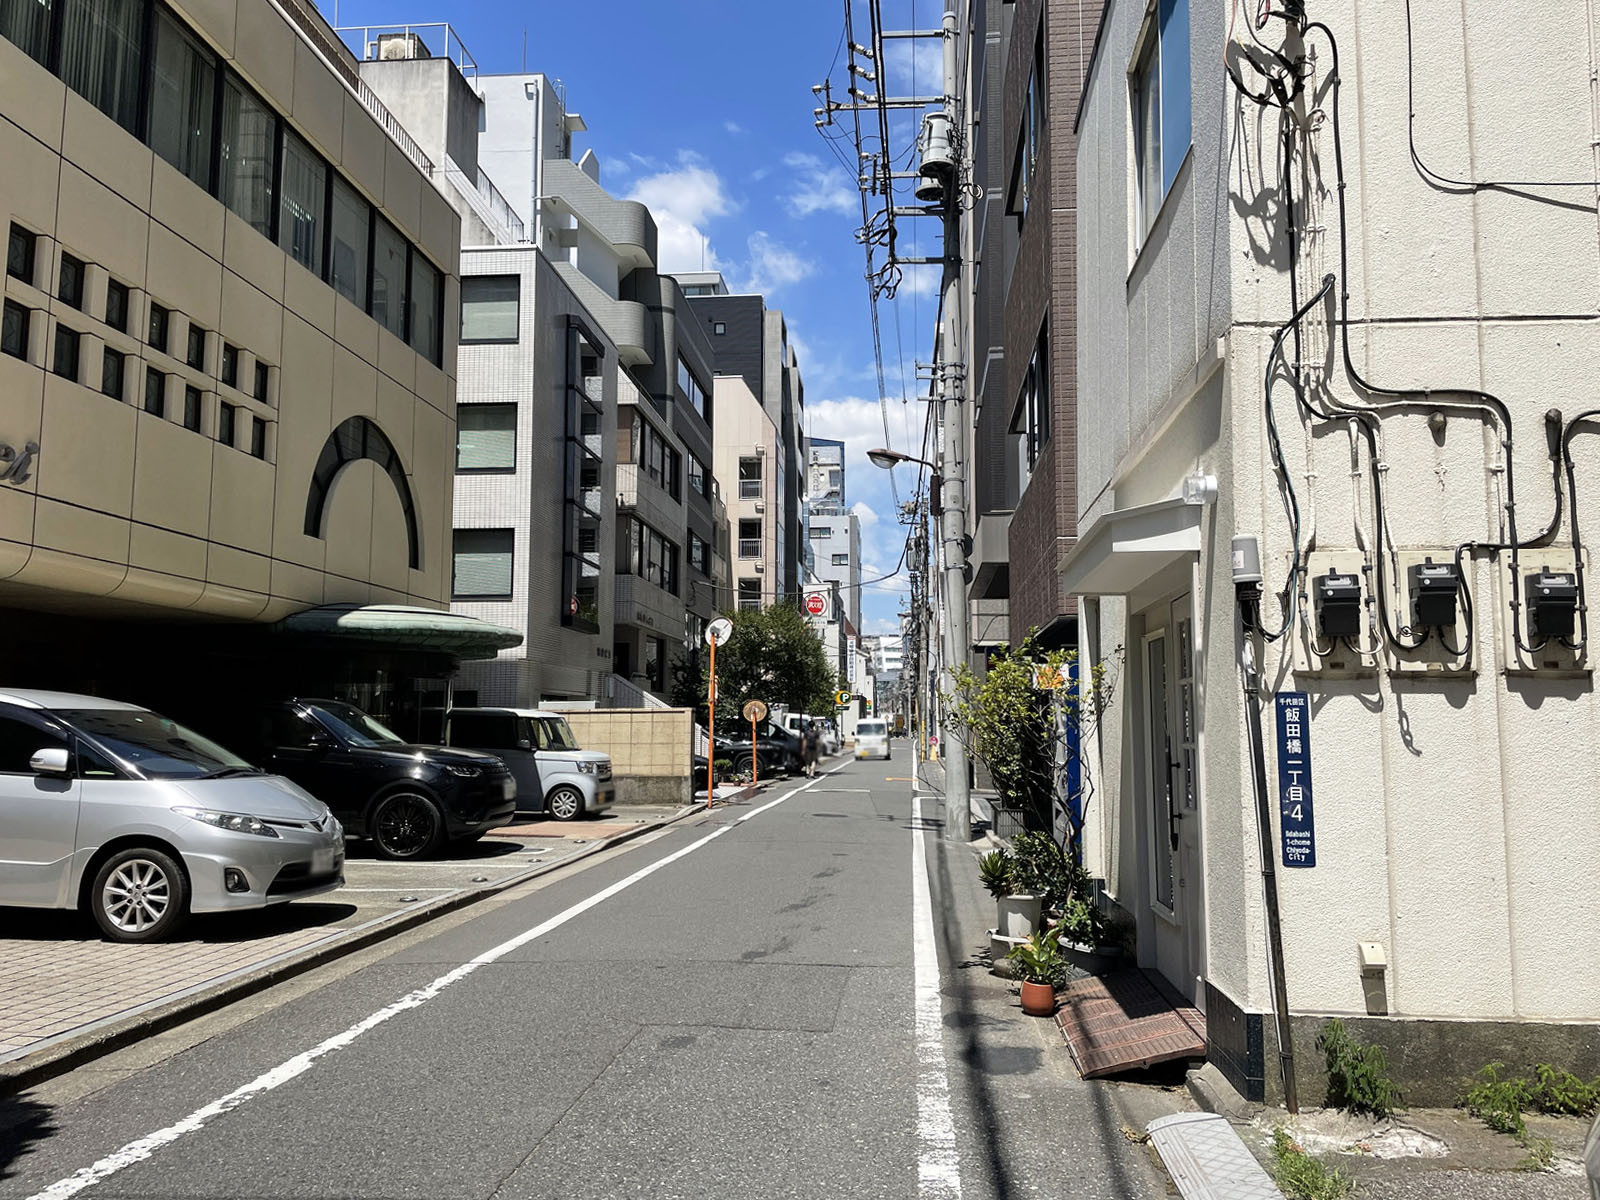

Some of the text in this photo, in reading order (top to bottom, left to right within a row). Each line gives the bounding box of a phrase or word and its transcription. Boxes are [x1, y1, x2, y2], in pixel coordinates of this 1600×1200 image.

[842, 693, 849, 702] P
[1279, 698, 1305, 706] 千代田区
[1288, 853, 1305, 862] City
